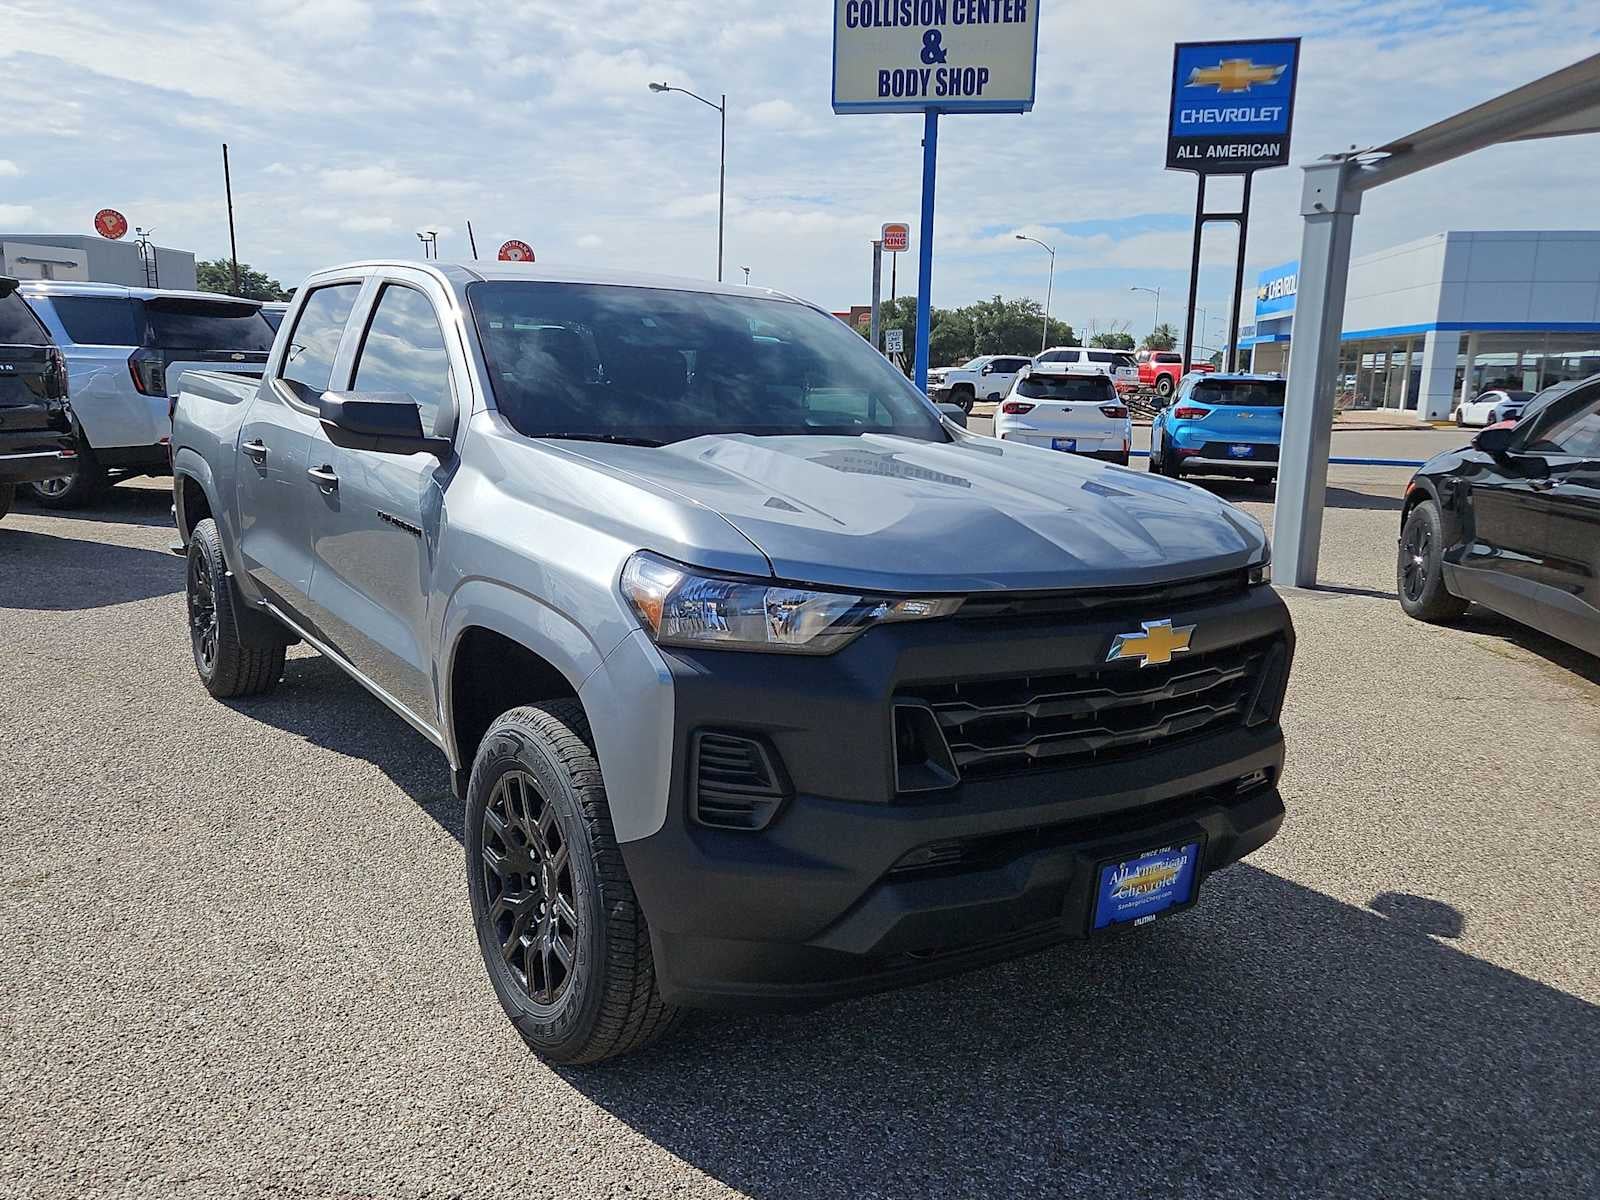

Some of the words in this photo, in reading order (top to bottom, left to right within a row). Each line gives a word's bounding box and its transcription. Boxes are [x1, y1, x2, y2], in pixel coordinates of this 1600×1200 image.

[846, 0, 946, 28] COLLISION
[952, 0, 1028, 25] CENTER
[921, 29, 948, 65] &
[878, 68, 931, 98] BODY
[935, 67, 990, 97] SHOP
[1180, 106, 1282, 123] CHEVROLET
[1176, 144, 1203, 159] ALL
[1206, 142, 1281, 158] AMERICAN
[888, 341, 902, 350] 35
[1131, 855, 1188, 877] American
[1118, 873, 1177, 899] Chevrolet
